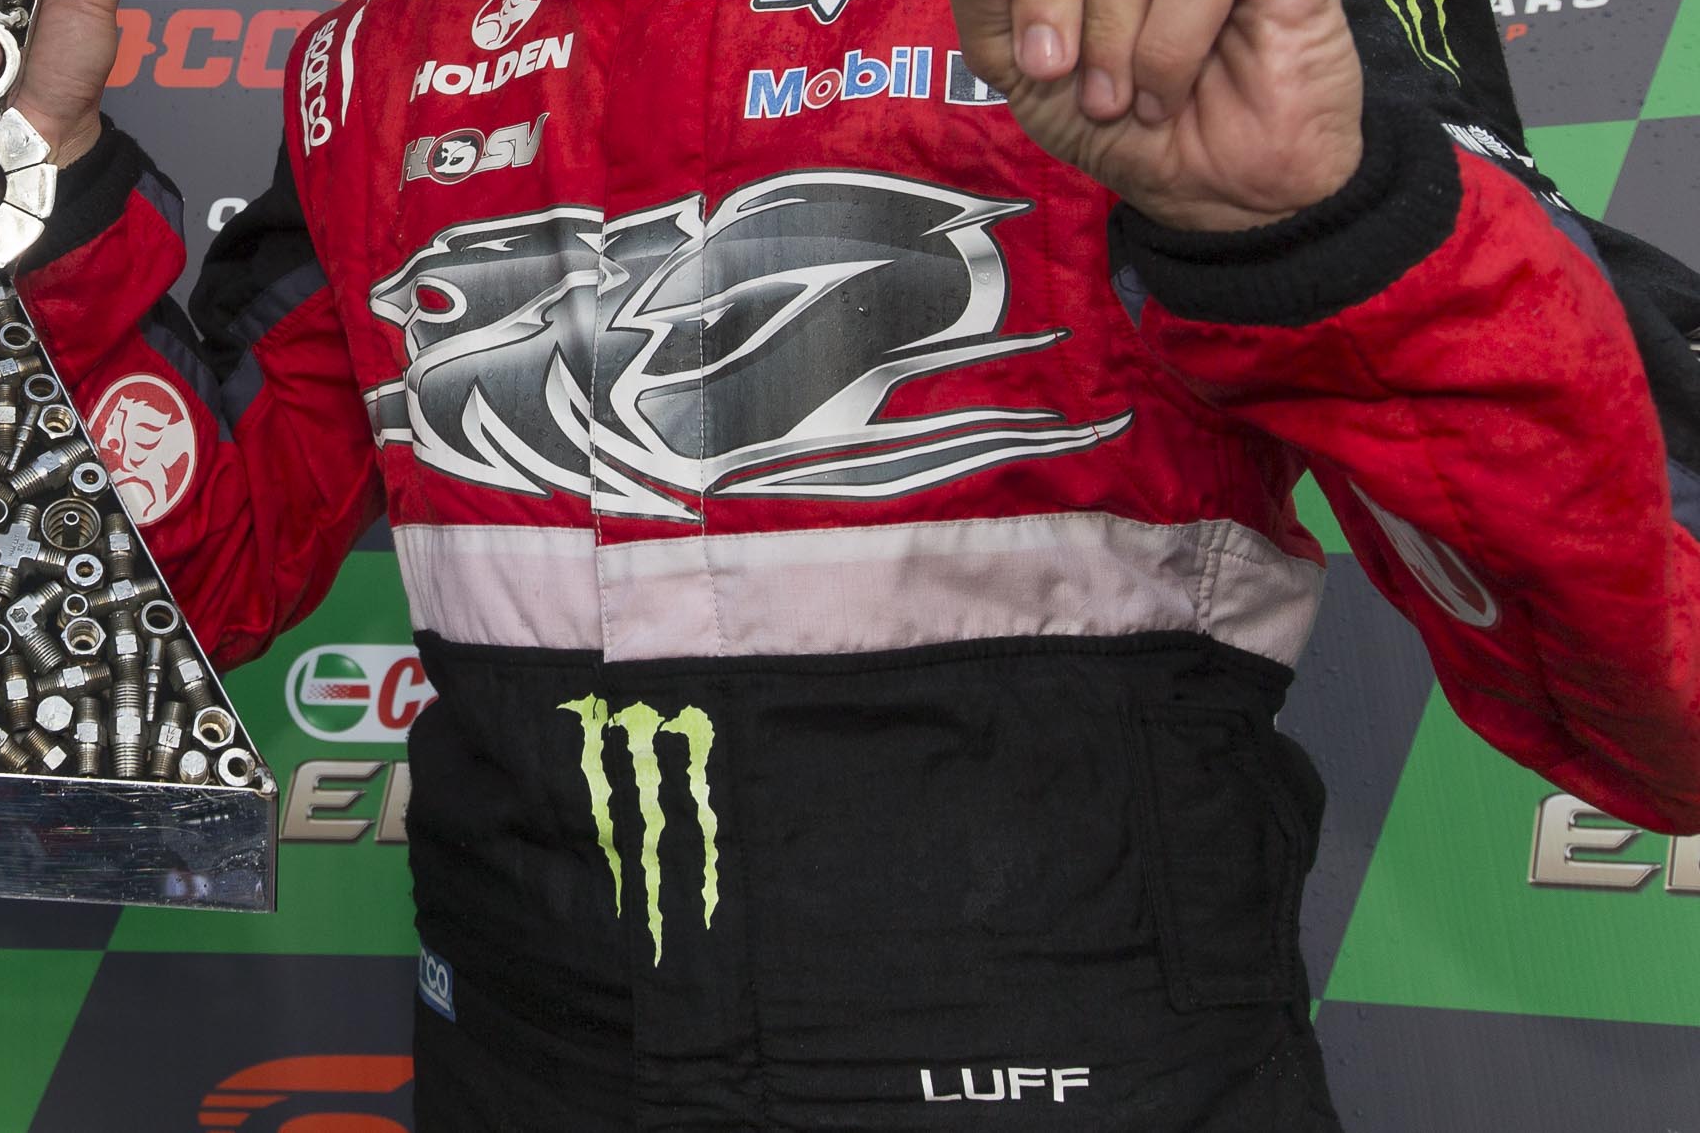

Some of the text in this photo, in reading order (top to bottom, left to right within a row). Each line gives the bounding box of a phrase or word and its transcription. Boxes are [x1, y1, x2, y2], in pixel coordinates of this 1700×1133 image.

[305, 19, 338, 148] sparco
[410, 33, 574, 103] HOLDEN
[744, 47, 932, 119] Mobil
[919, 1067, 1090, 1103] LUFF
